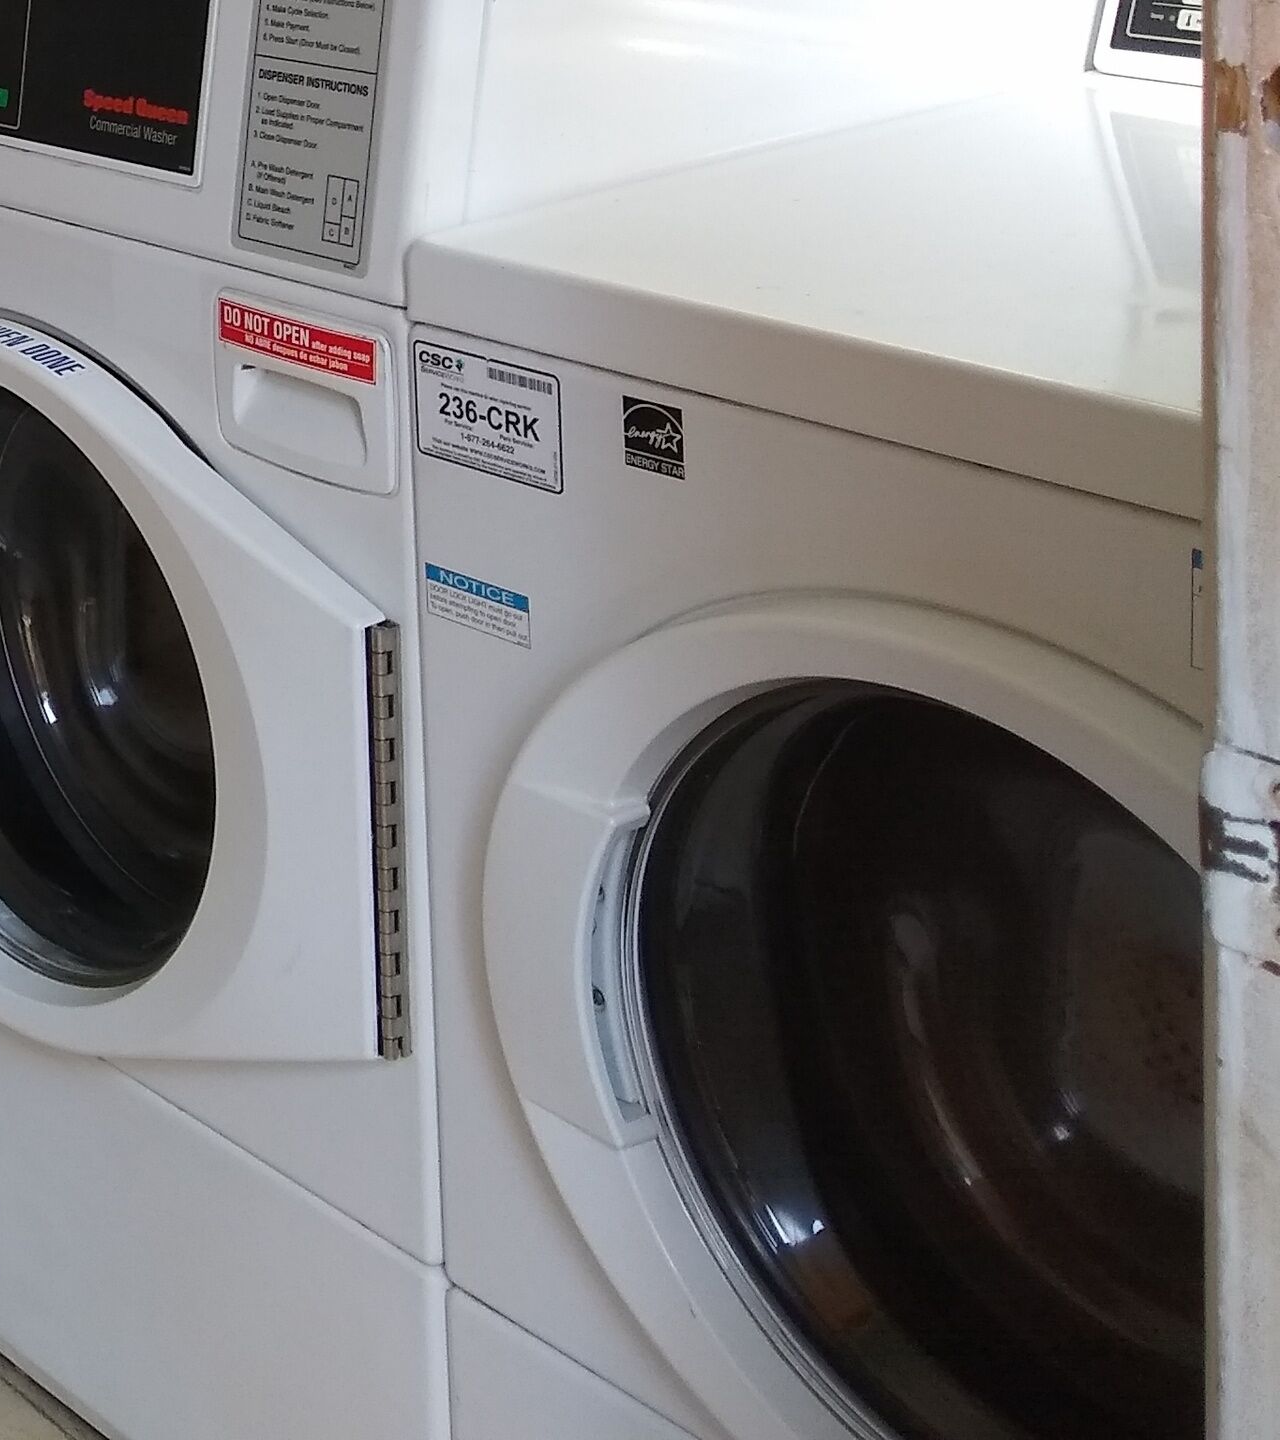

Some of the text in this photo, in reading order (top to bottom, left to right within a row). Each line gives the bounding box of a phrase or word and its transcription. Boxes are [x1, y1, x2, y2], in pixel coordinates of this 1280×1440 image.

[258, 68, 369, 97] DISPENSER INSTRUCTIONS
[89, 115, 178, 146] Commercial Washer
[223, 304, 370, 364] DO NOT OPEN after adding soap
[18, 343, 86, 376] DONE
[419, 350, 454, 370] CSC
[438, 392, 541, 442] 236-CRK
[627, 425, 662, 448] energy
[625, 453, 685, 478] ENERGY STAR
[440, 569, 516, 606] NOTICE
